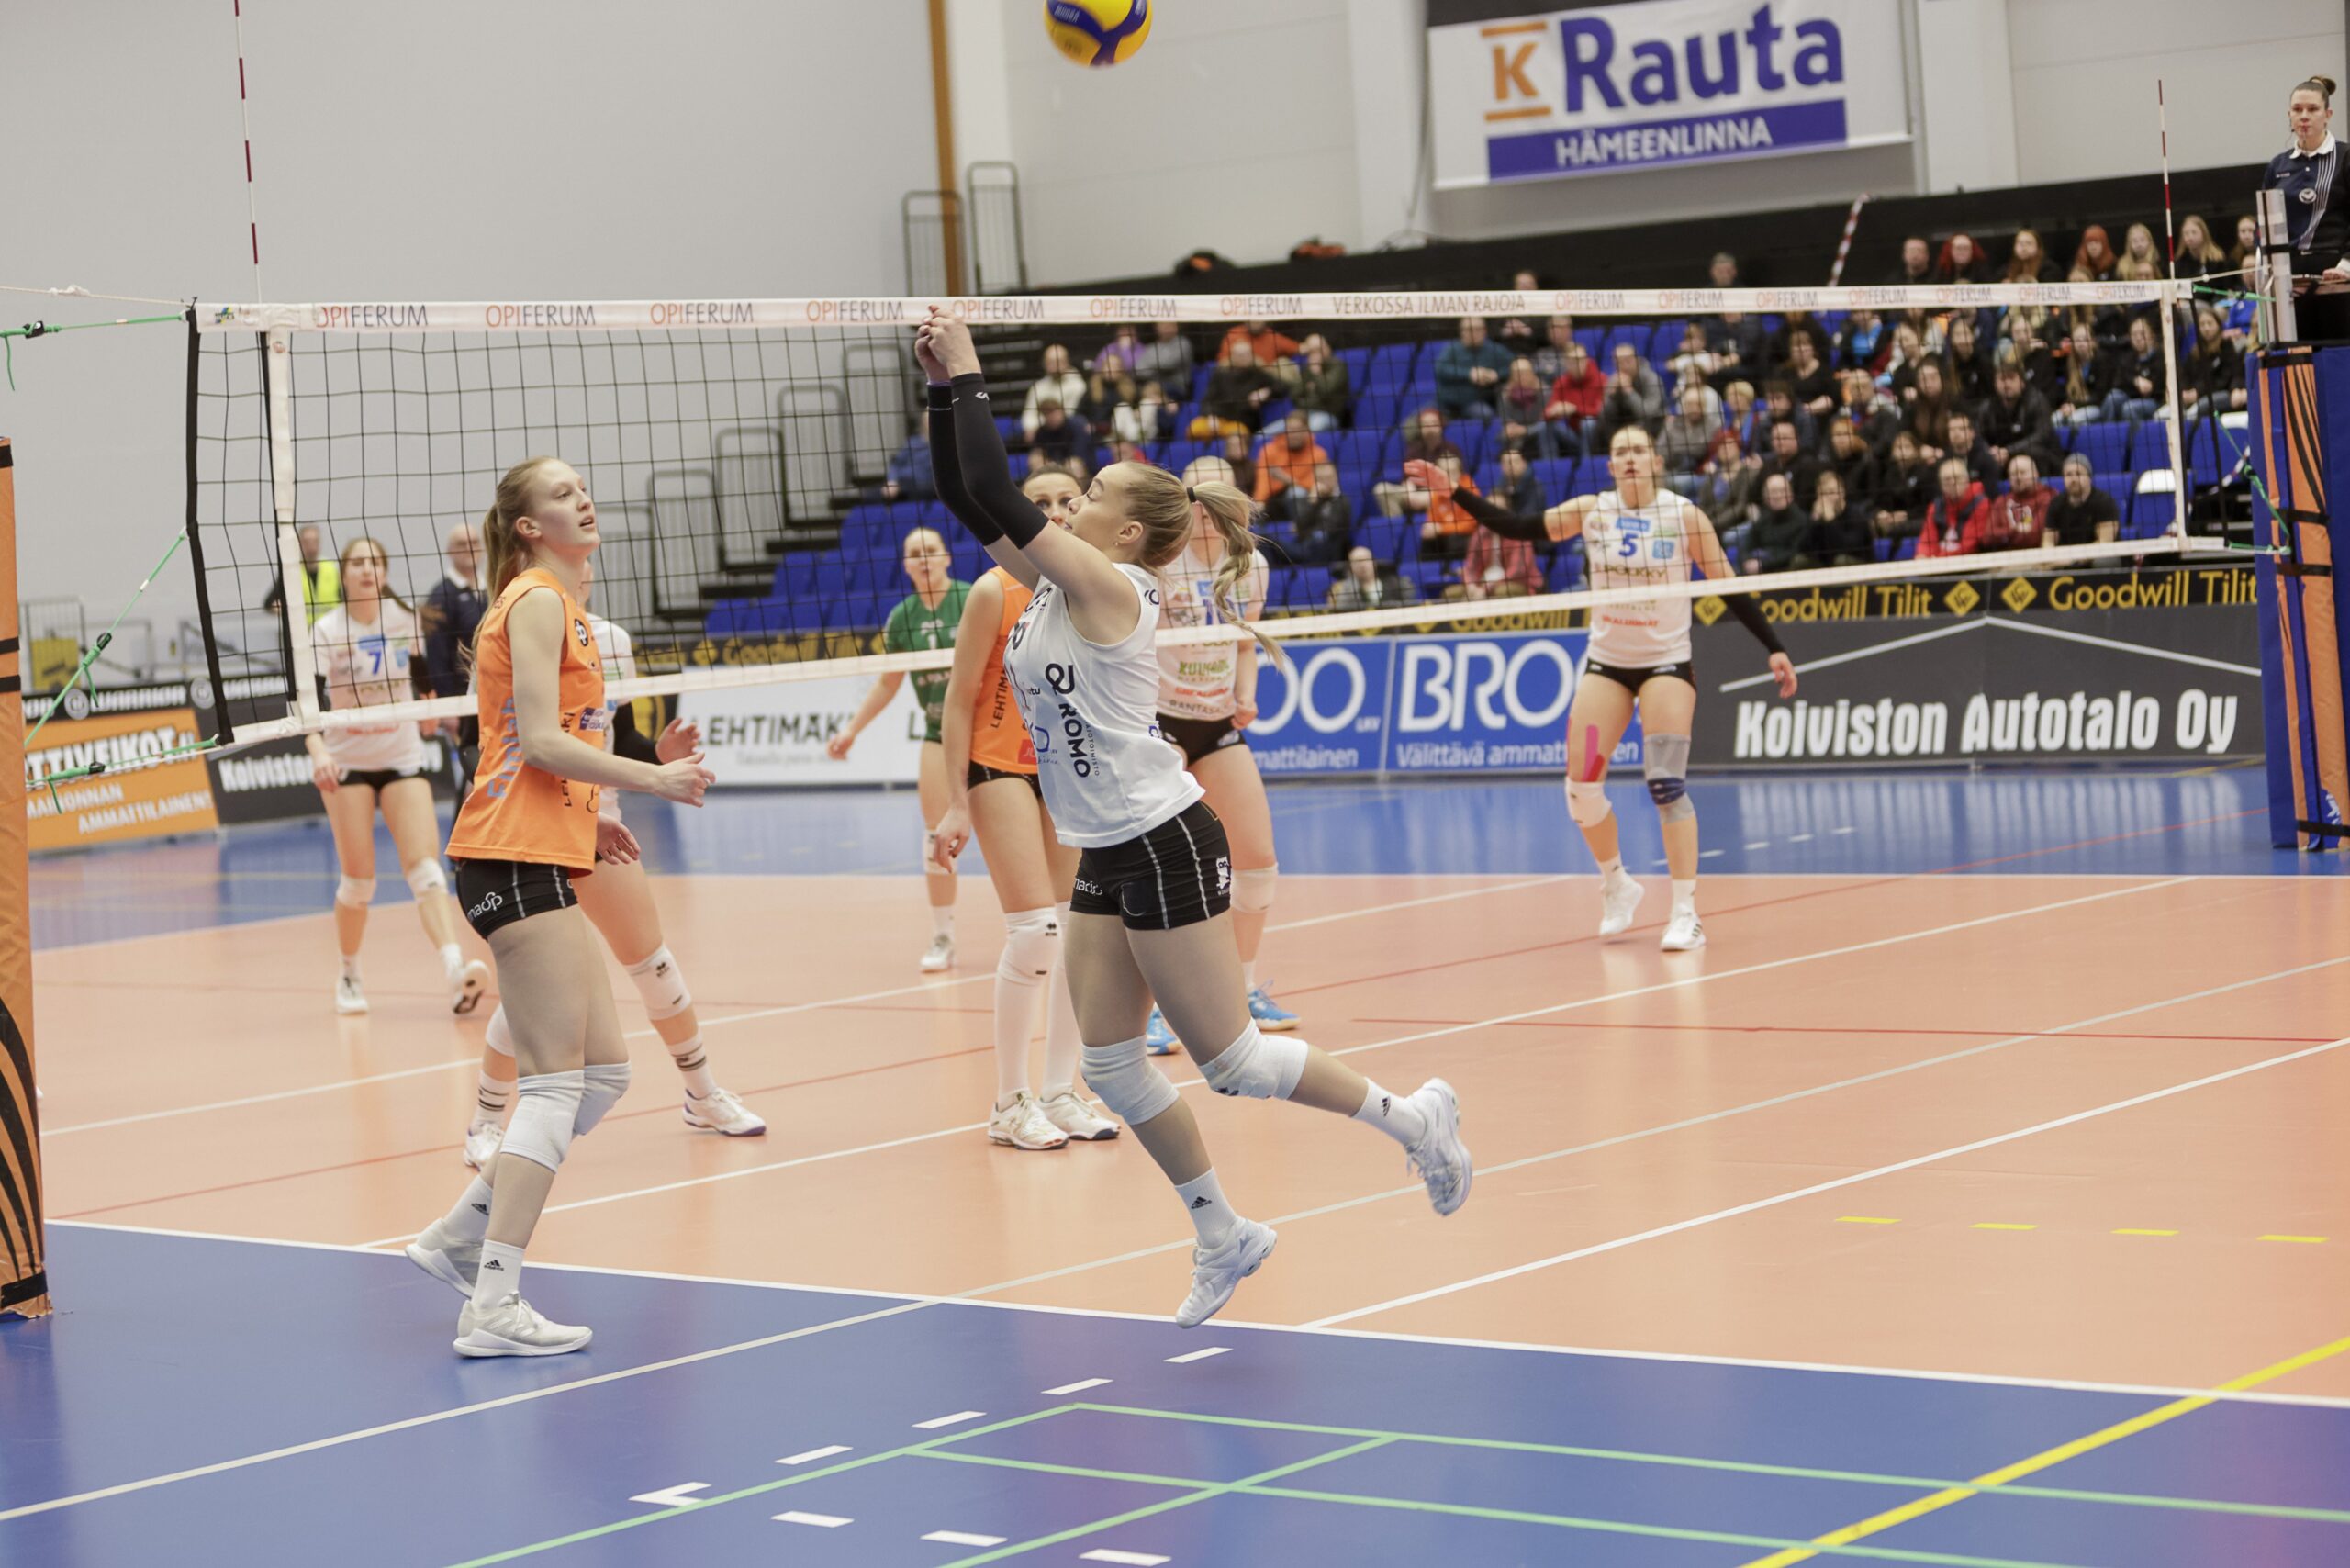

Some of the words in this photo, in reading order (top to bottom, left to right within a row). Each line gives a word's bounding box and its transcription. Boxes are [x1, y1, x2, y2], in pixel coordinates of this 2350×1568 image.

[1493, 41, 1539, 102] K
[1561, 3, 1845, 113] Rauta
[1555, 116, 1774, 168] HÄMEENLINNA
[485, 304, 597, 327] OPIFERUM
[649, 302, 755, 326] OPIFERUM
[806, 300, 904, 322] OPIFERUM
[1090, 297, 1177, 319] OPIFERUM
[1220, 296, 1303, 316] OPIFERUM
[1333, 294, 1414, 315] VERKOSSA
[1418, 295, 1469, 314] ILMAN
[1473, 293, 1526, 313] RAJOJA
[1554, 292, 1626, 311] OPIFERUM
[1658, 291, 1724, 309] OPIFERUM
[1755, 290, 1819, 309] OPIFERUM
[1846, 286, 1908, 306] OPIFERUM
[1935, 286, 1992, 304] OPIFERUM
[1618, 533, 1639, 557] 5
[1750, 585, 1869, 625] oodwill
[1874, 583, 1933, 619] Tilit
[2048, 569, 2190, 611] Goodwill
[2199, 567, 2257, 607] Tilit
[368, 650, 382, 676] 7
[1399, 638, 1591, 732] BRO
[990, 670, 1011, 729] LEHTIM
[1734, 696, 1949, 758] Koiviston
[1959, 689, 2160, 754] Autotalo
[2176, 689, 2238, 754] Oy
[1058, 701, 1091, 779] ROMO
[1085, 719, 1101, 777] AJOTOIMISTO
[1395, 740, 1484, 767] Välittävä
